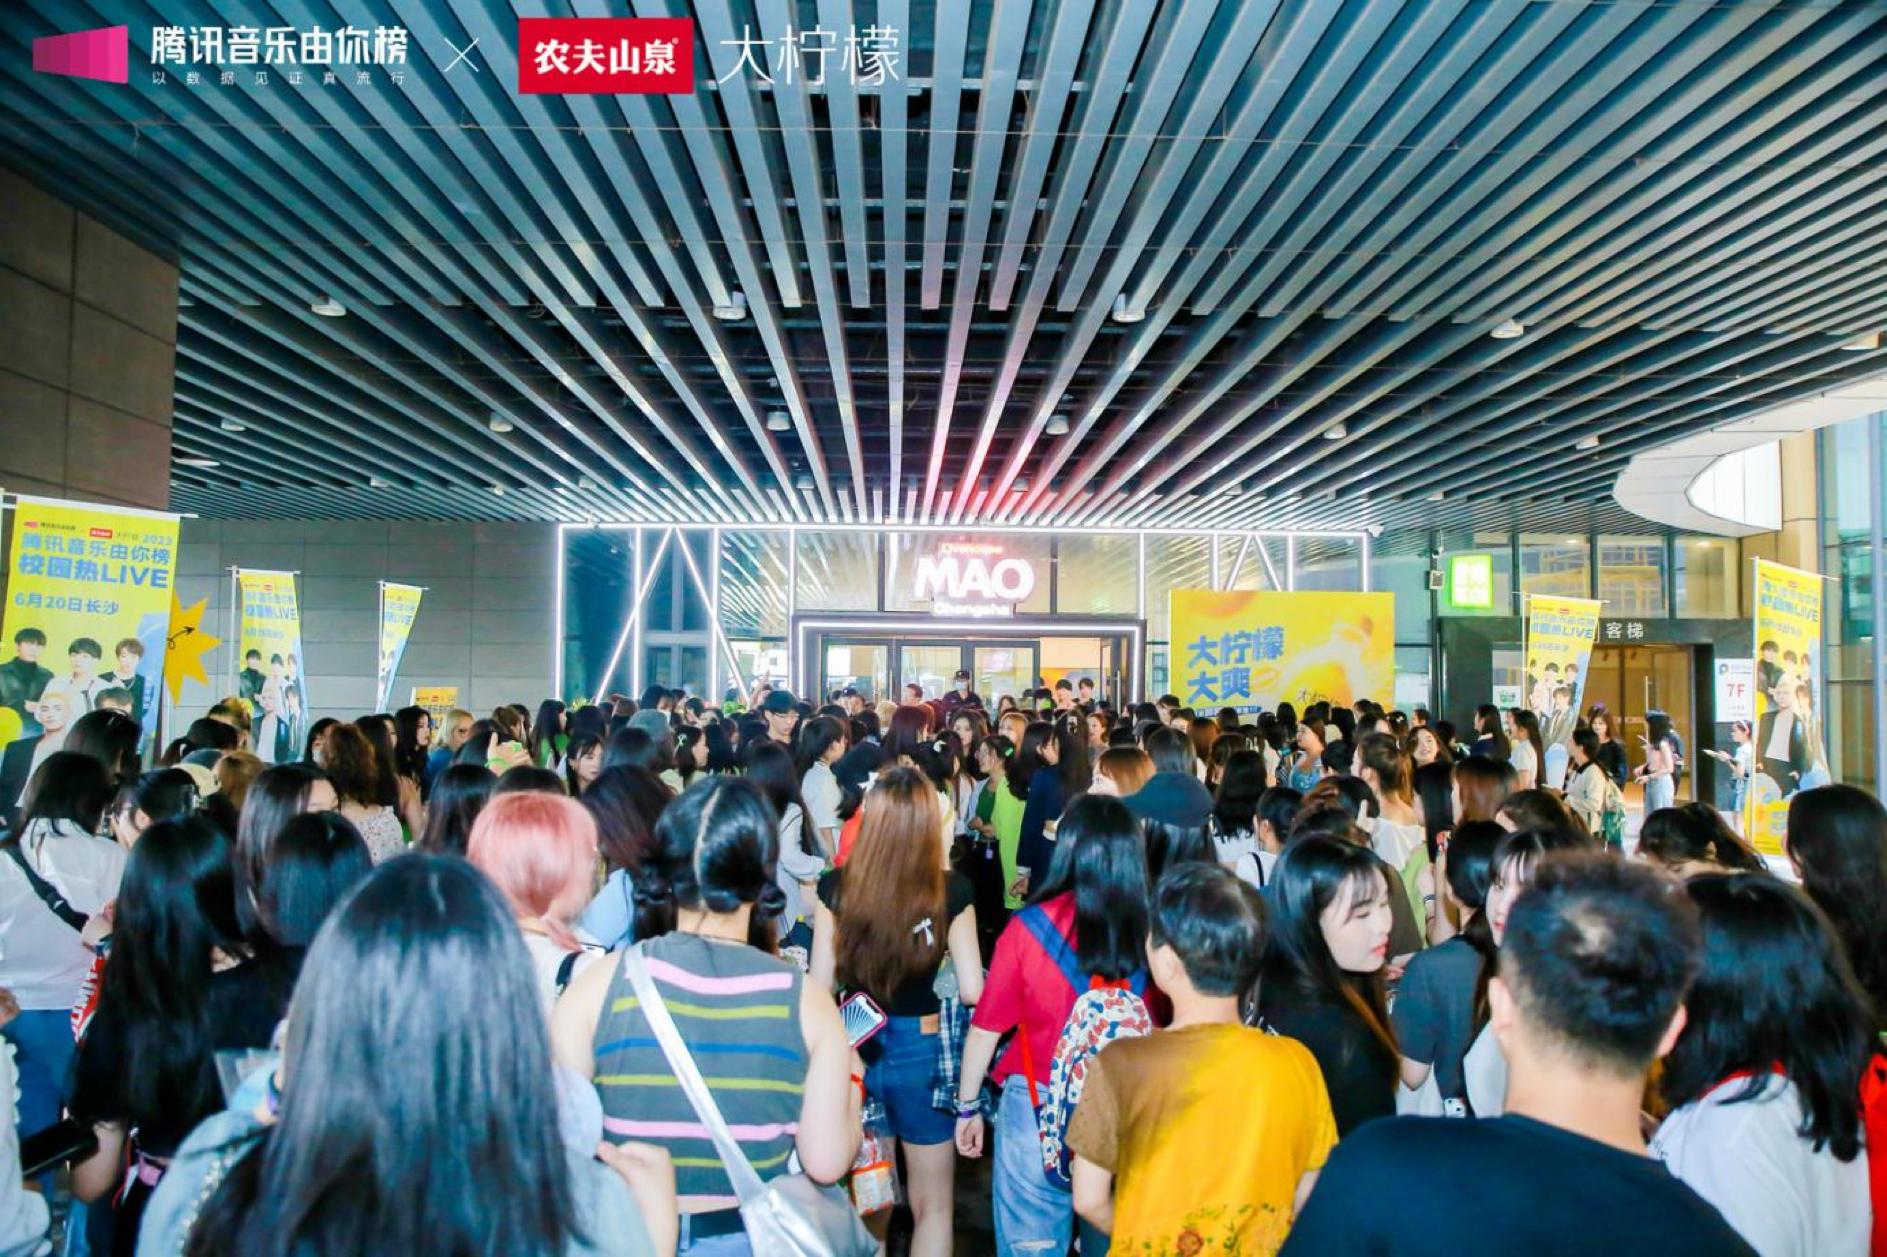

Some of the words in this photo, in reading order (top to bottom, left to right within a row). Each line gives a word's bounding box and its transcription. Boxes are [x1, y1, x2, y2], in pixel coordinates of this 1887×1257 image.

[21, 532, 170, 565] 腾讯音乐由你榜
[914, 556, 1035, 600] MAO
[1187, 626, 1285, 668] 大柠檬
[1606, 622, 1645, 640] 客梯
[1187, 667, 1251, 704] 大爽
[1726, 683, 1745, 698] 7F
